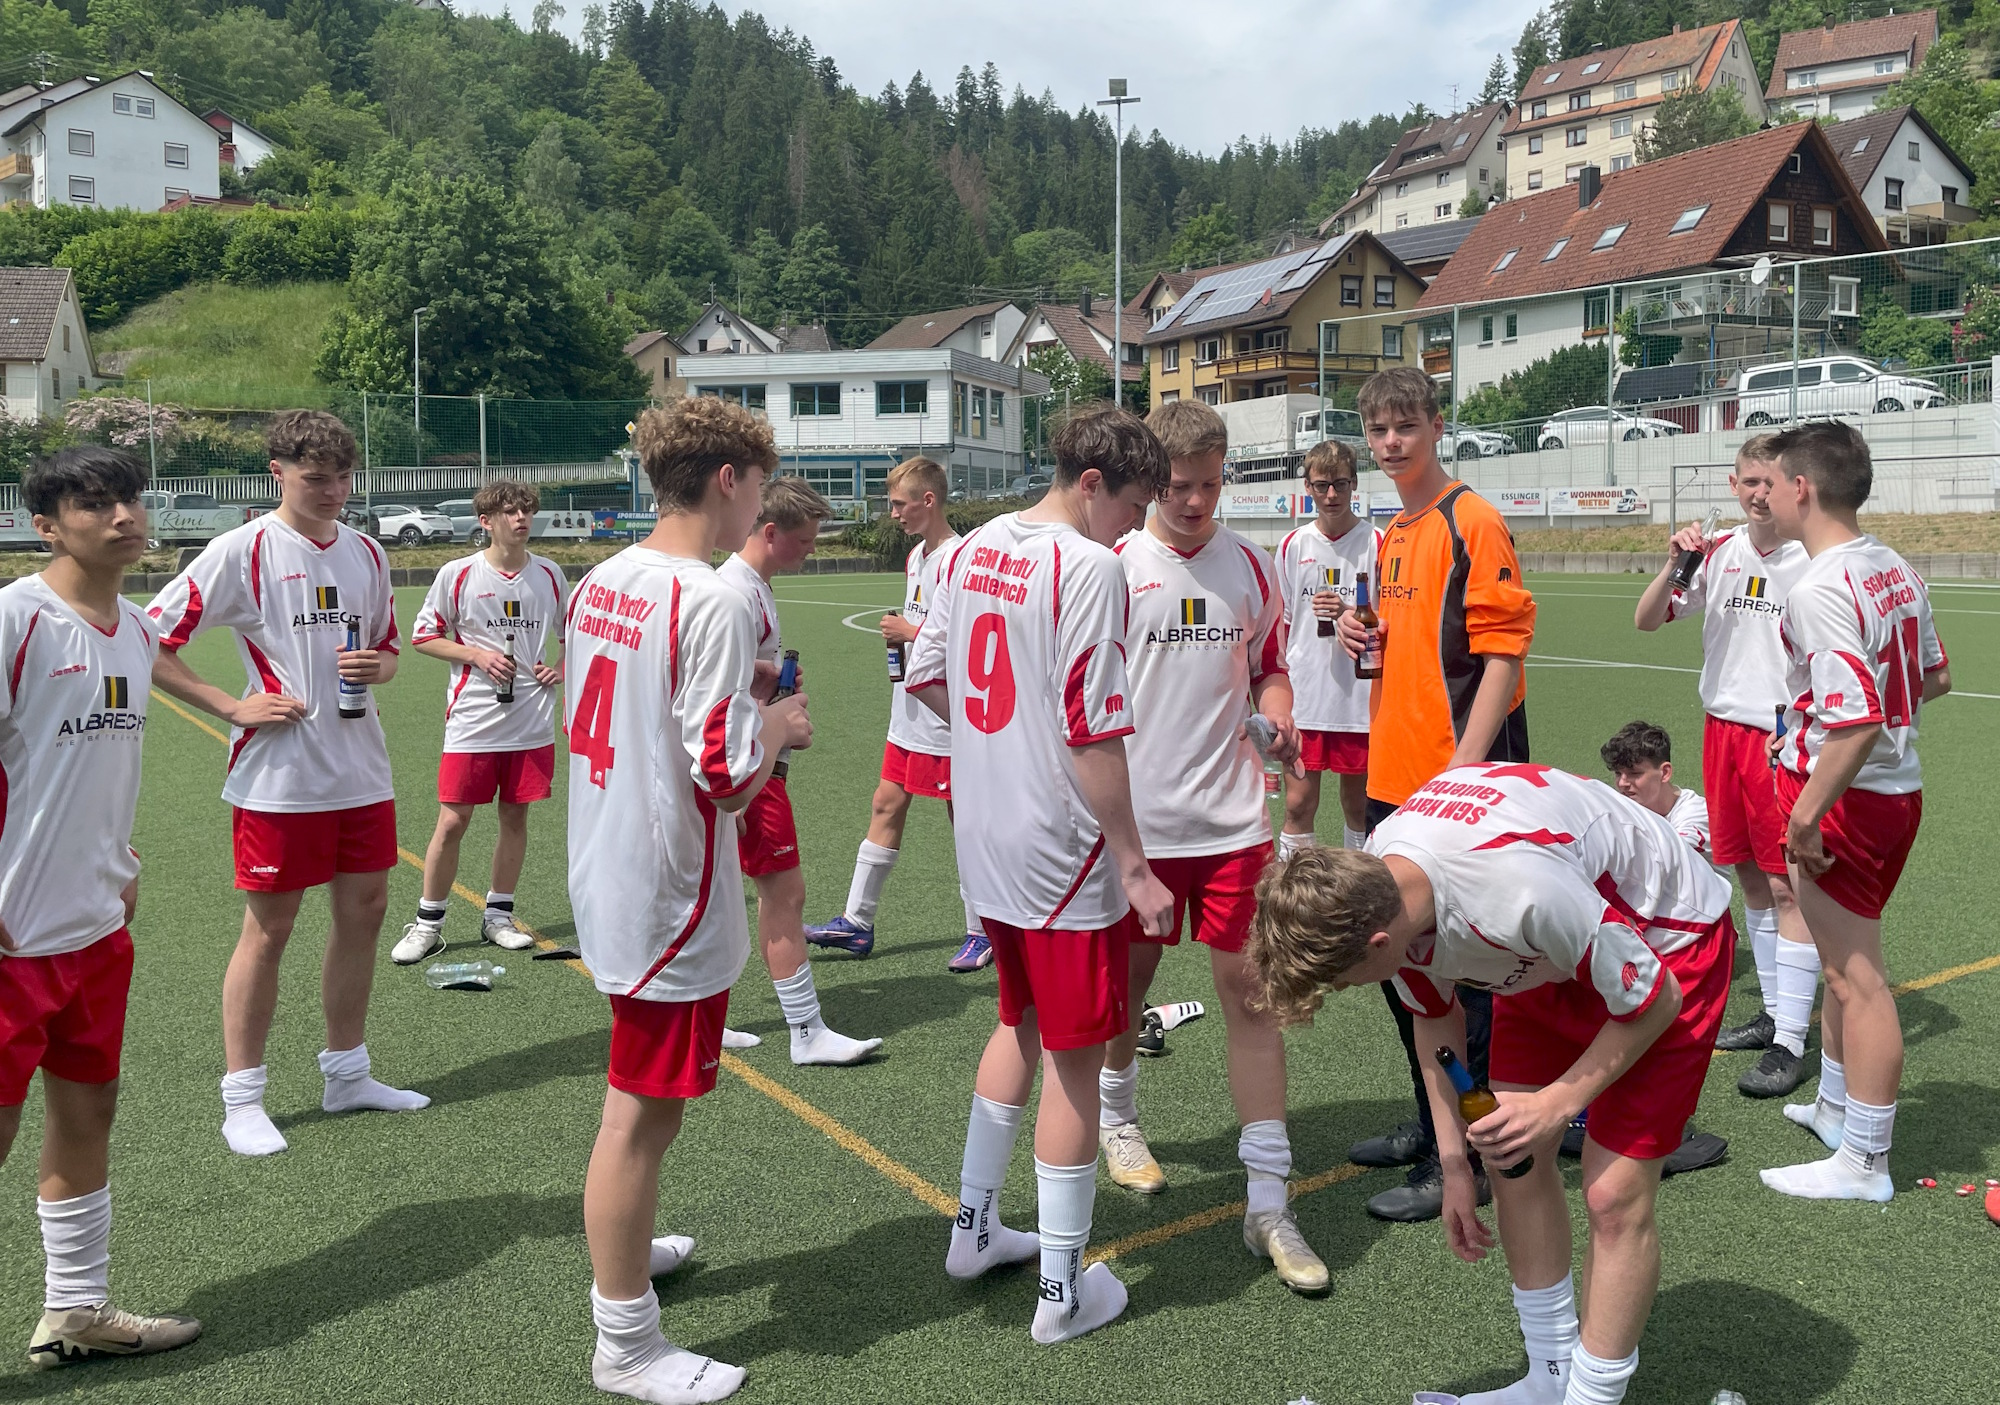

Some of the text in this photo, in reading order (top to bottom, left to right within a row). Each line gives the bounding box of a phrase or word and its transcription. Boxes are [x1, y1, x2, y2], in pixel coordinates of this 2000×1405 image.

[1232, 495, 1270, 504] SCHNURR
[1501, 492, 1540, 500] ESSLINGER
[1578, 499, 1610, 507] MIETEN
[159, 510, 206, 531] Rimi
[585, 583, 616, 613] SGM
[1146, 627, 1244, 645] ALBRECHT
[965, 612, 1016, 734] 9
[570, 654, 618, 790] 4
[1437, 800, 1488, 826] SGM
